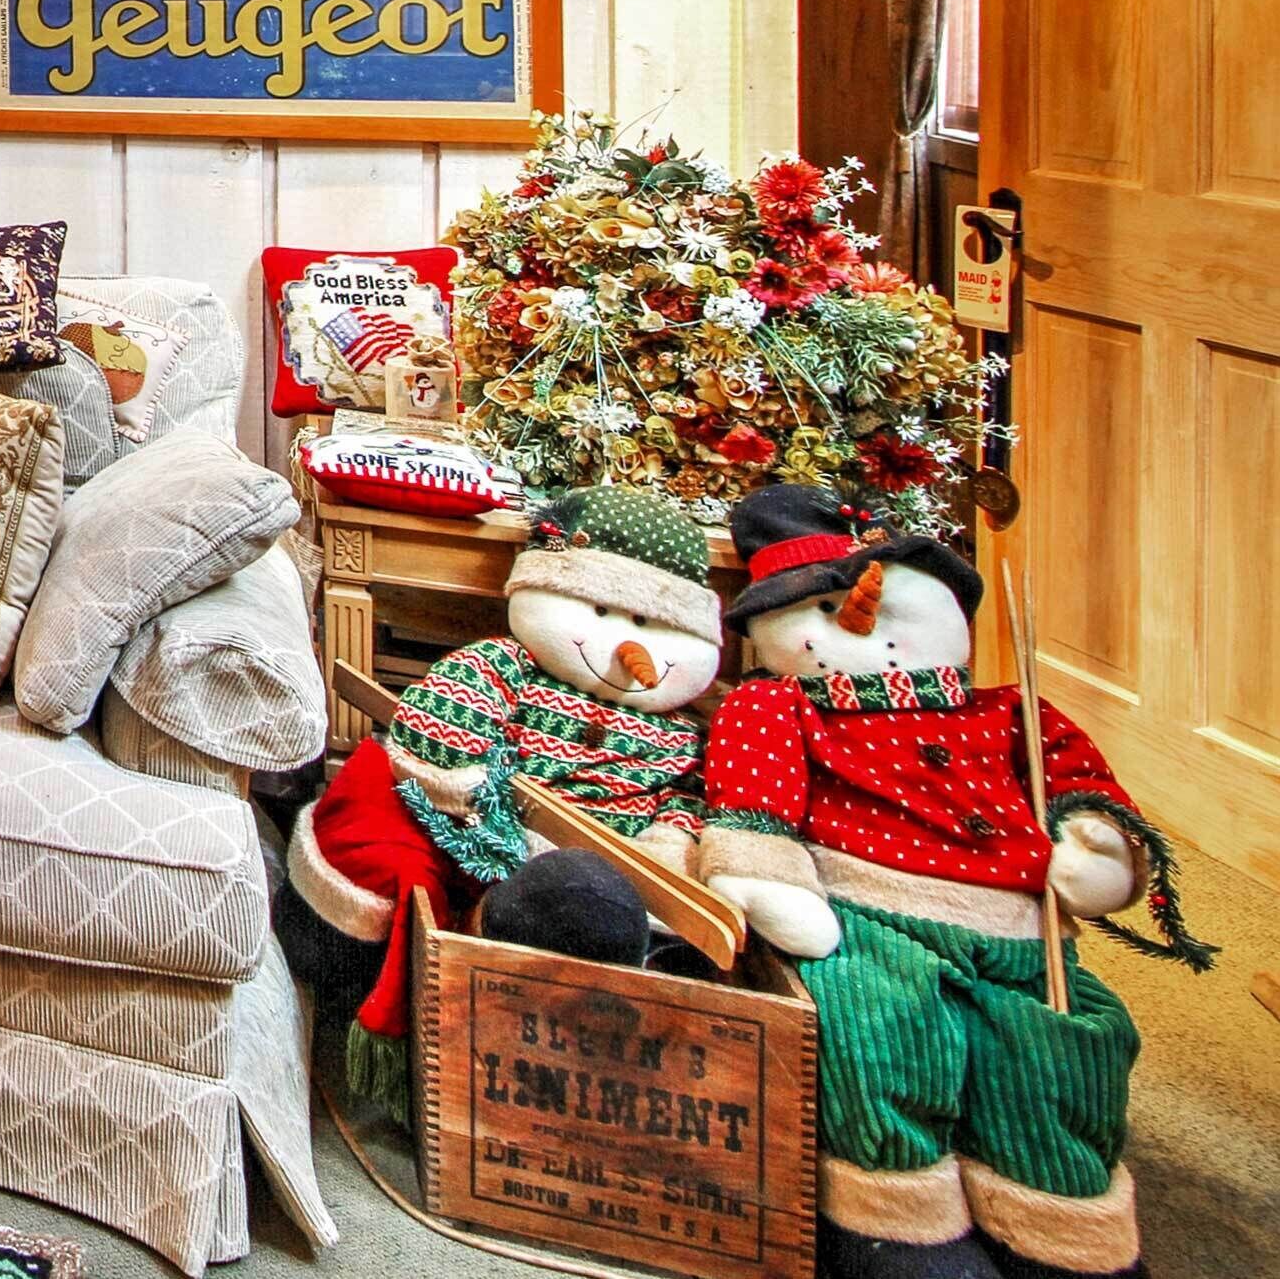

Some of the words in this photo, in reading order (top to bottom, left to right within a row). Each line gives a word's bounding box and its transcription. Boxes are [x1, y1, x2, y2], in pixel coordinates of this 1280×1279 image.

[313, 273, 352, 289] God
[355, 274, 409, 291] Bless
[958, 271, 987, 285] MAID
[320, 288, 408, 307] America
[336, 453, 399, 470] GONE
[405, 460, 482, 485] SKIING
[483, 1052, 750, 1153] LINIMENT
[502, 1178, 570, 1209] BOSTON
